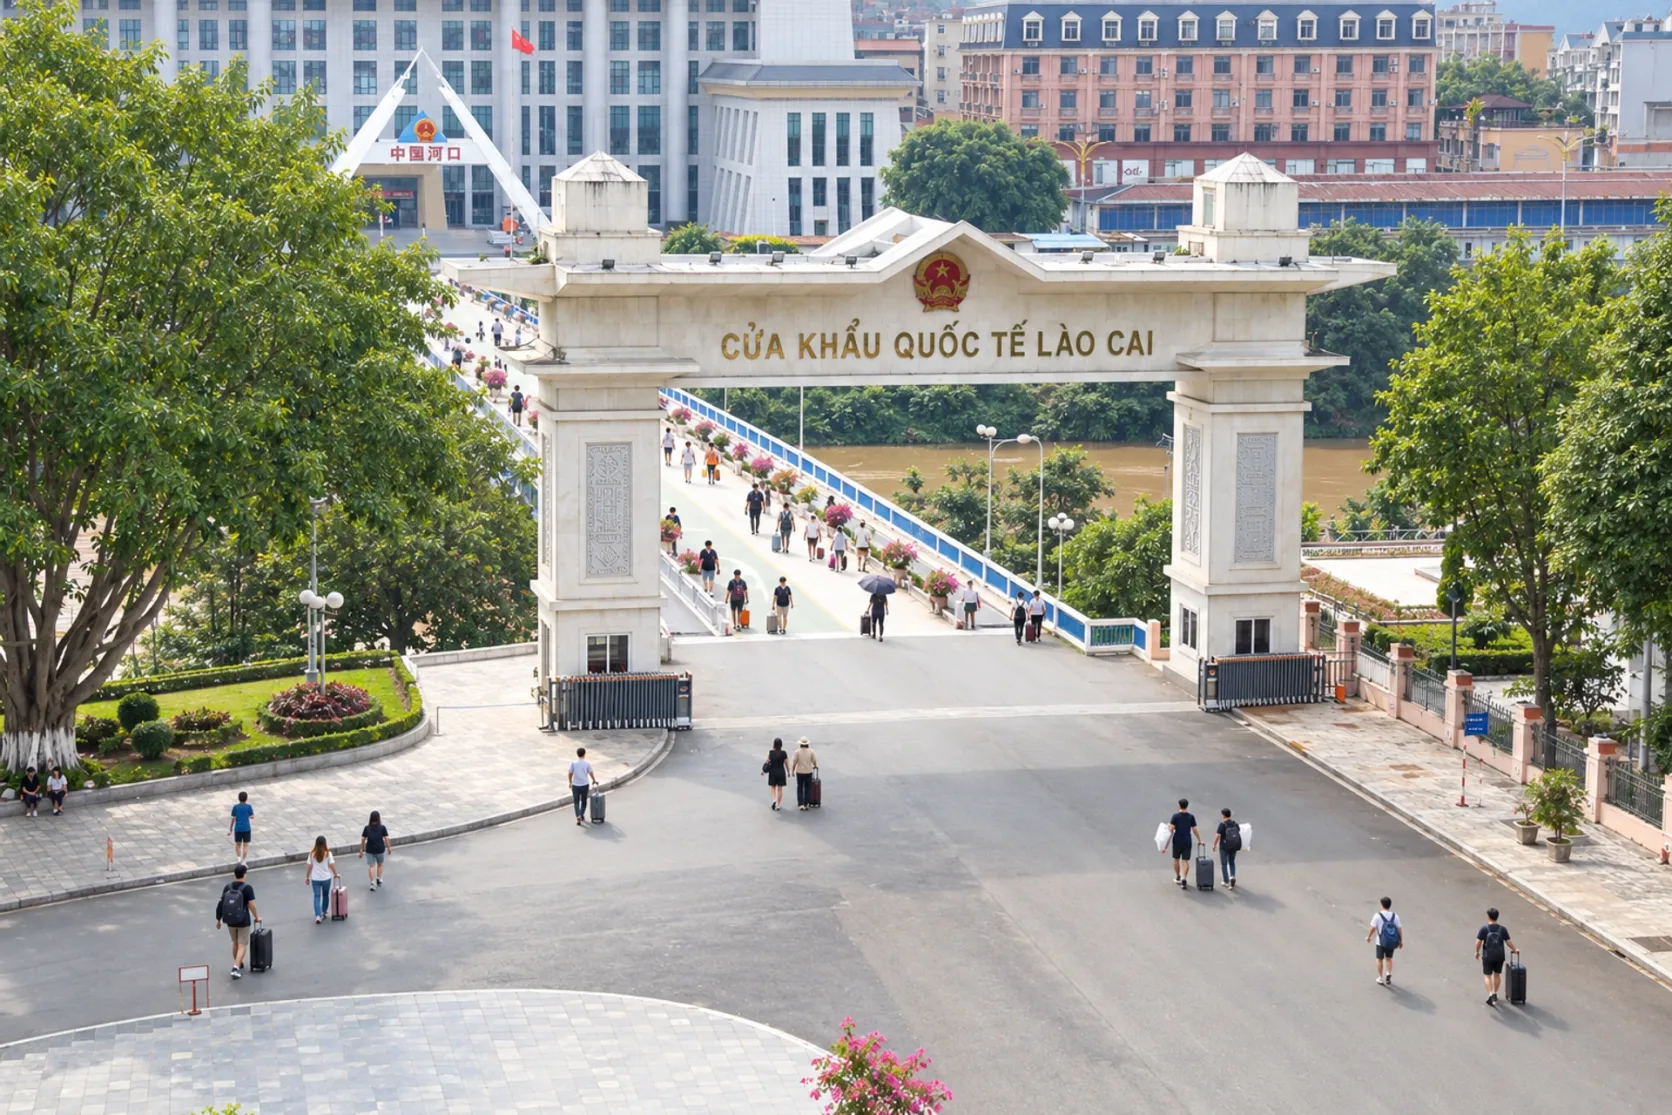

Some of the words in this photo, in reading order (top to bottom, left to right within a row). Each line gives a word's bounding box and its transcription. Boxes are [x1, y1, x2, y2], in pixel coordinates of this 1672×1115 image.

[390, 145, 461, 162] 中国河口
[721, 321, 785, 360] CỬA
[798, 318, 881, 359] KHẨU
[894, 320, 980, 360] QUỐC
[991, 319, 1028, 357] TẾ
[1037, 323, 1096, 357] LÀO
[1107, 330, 1154, 356] CAI
